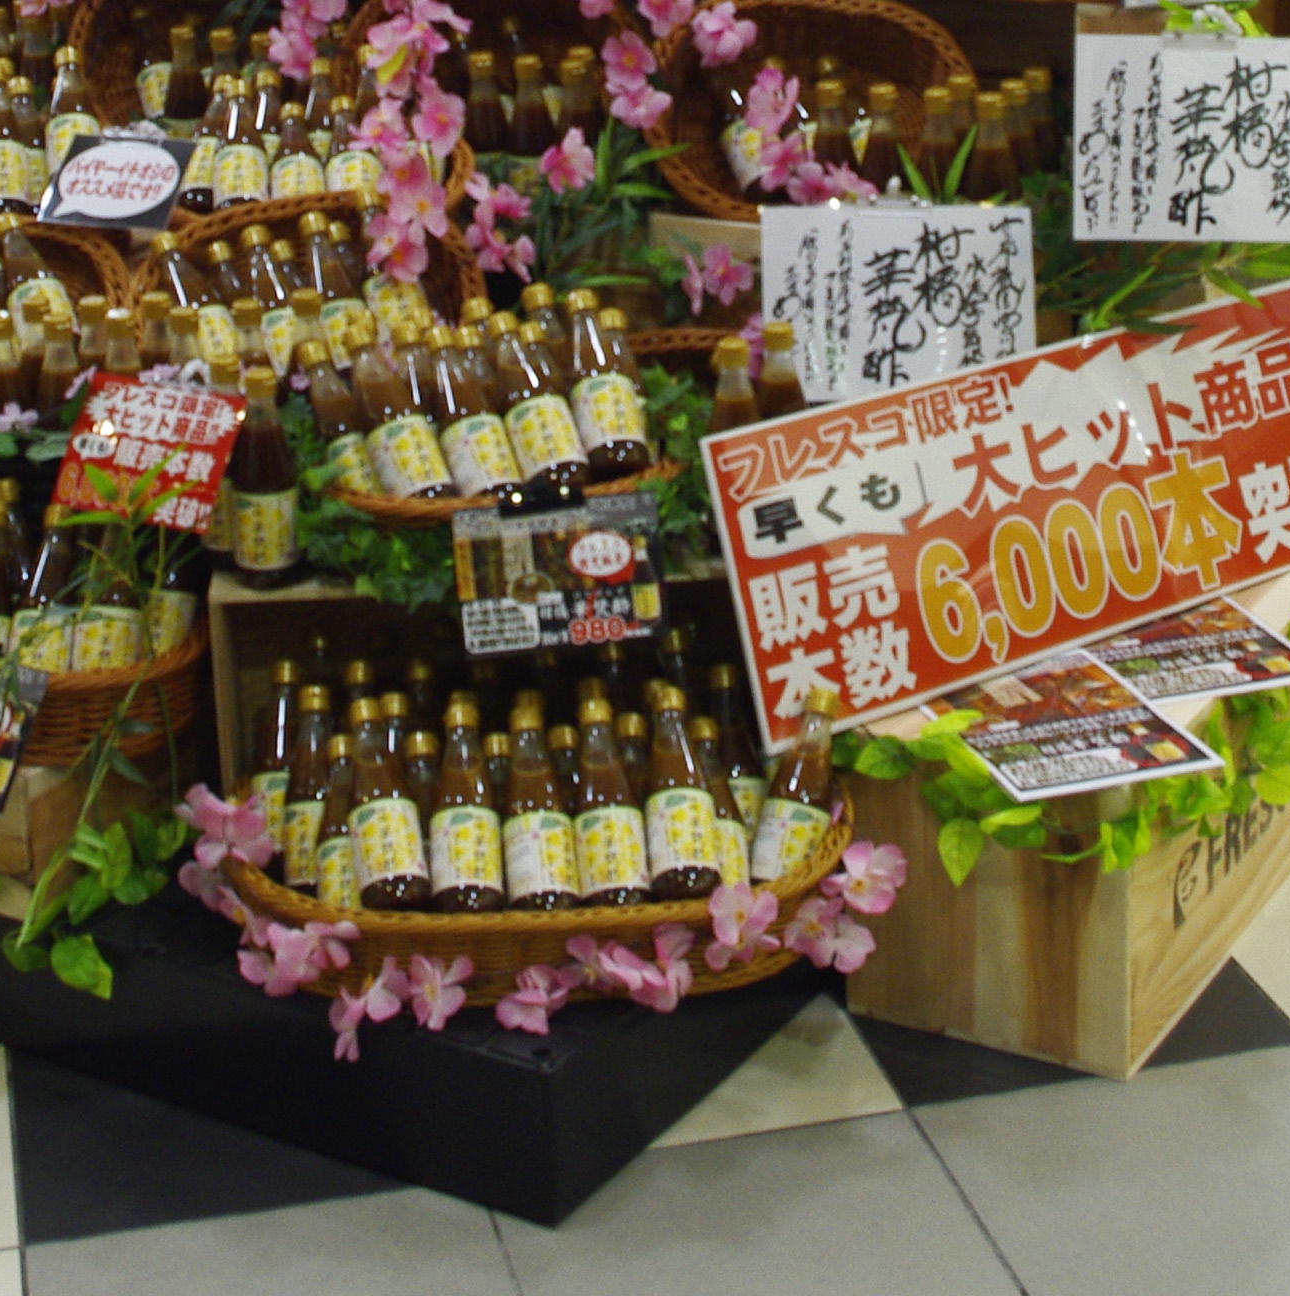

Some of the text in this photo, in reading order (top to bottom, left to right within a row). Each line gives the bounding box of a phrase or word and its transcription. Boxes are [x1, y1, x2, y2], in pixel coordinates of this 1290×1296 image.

[719, 373, 1016, 501] フレスコ限定!
[754, 472, 902, 545] 早くも
[568, 614, 627, 646] 980
